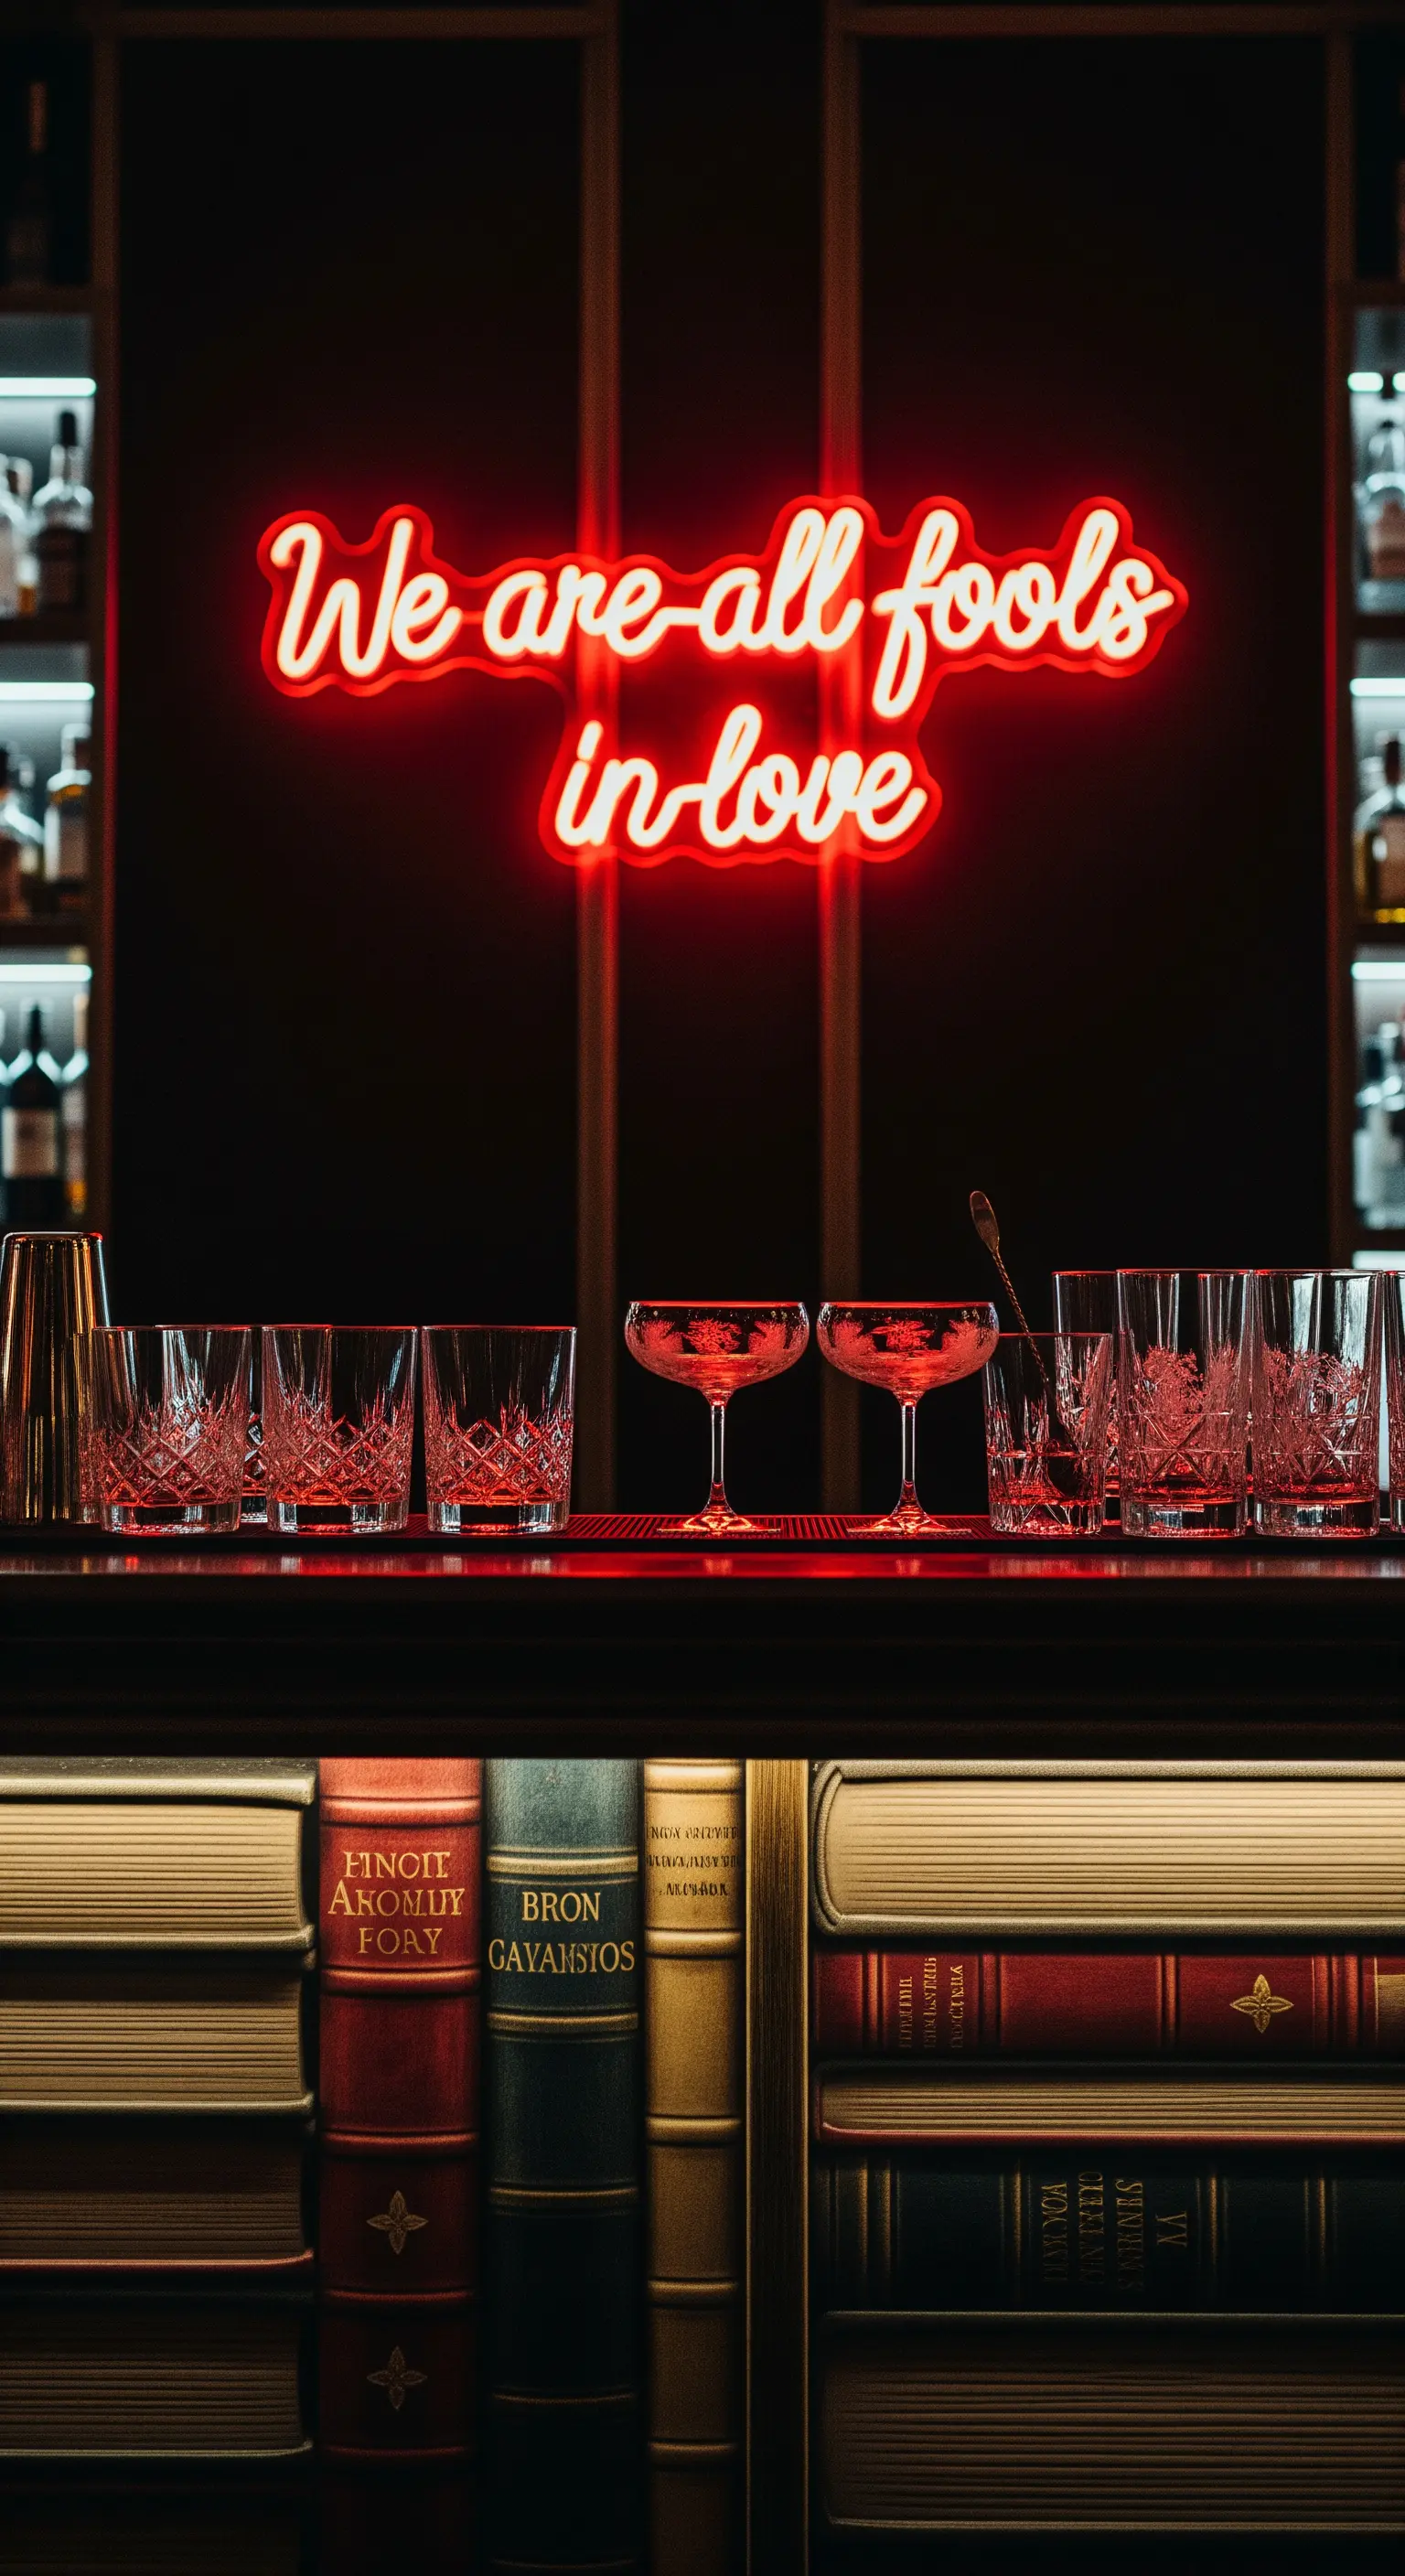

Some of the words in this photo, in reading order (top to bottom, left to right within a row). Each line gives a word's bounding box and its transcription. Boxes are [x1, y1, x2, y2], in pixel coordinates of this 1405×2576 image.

[272, 518, 461, 679] We
[482, 565, 662, 660] are
[700, 506, 864, 657] all
[873, 509, 1174, 719] fools
[554, 720, 697, 849] in
[700, 703, 928, 849] love
[521, 1891, 601, 1923] BRON
